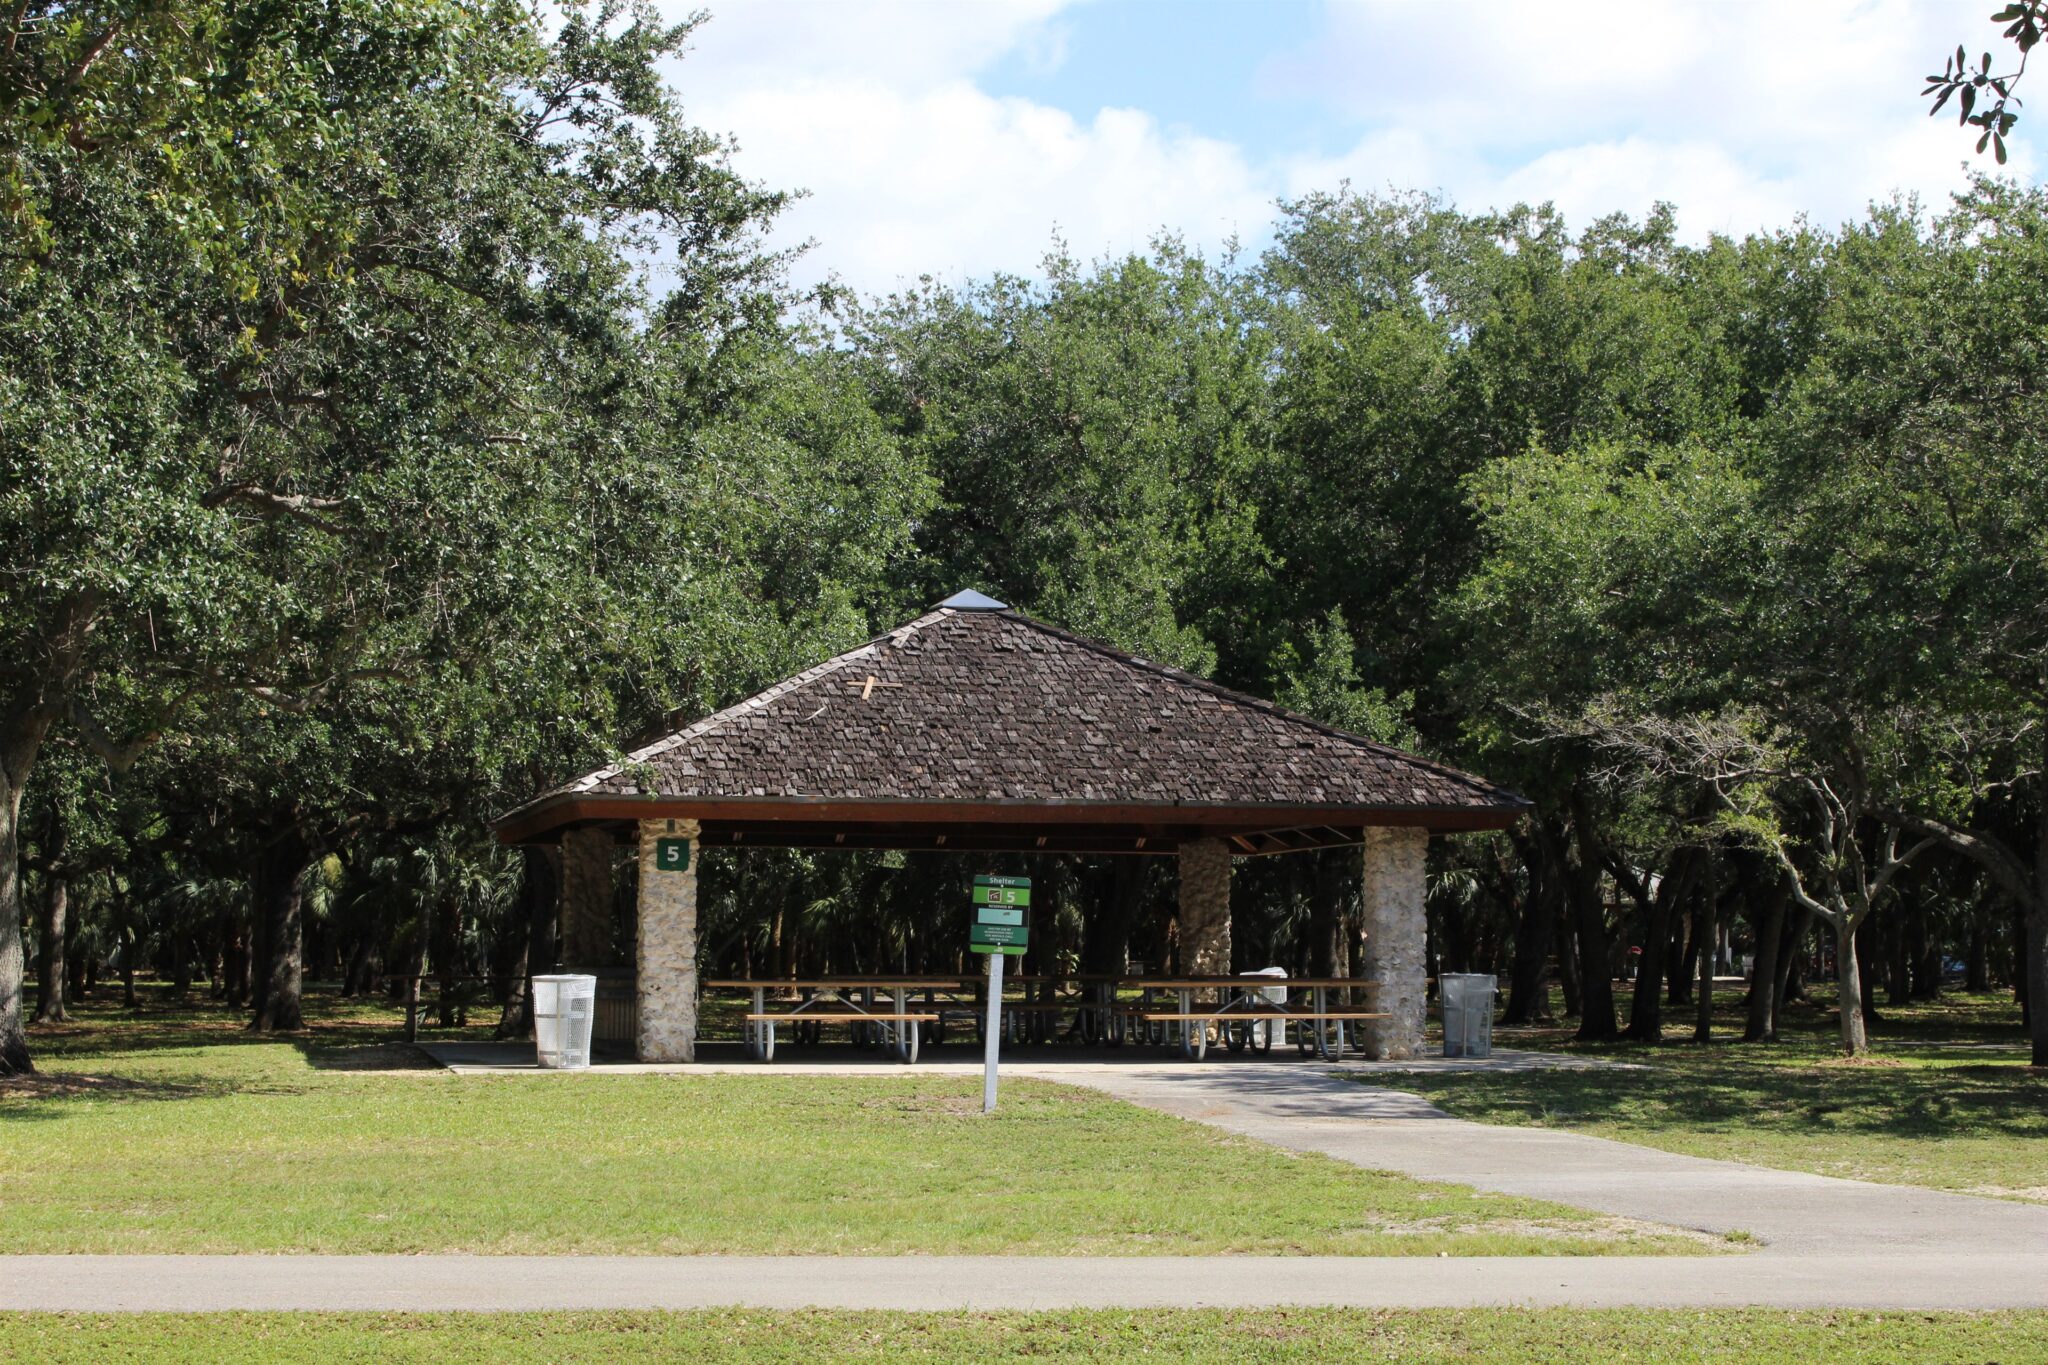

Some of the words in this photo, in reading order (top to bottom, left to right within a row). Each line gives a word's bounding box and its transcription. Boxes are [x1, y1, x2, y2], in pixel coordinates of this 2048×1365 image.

[667, 846, 679, 862] 5
[989, 877, 1015, 885] Shelter
[1007, 891, 1016, 903] 5
